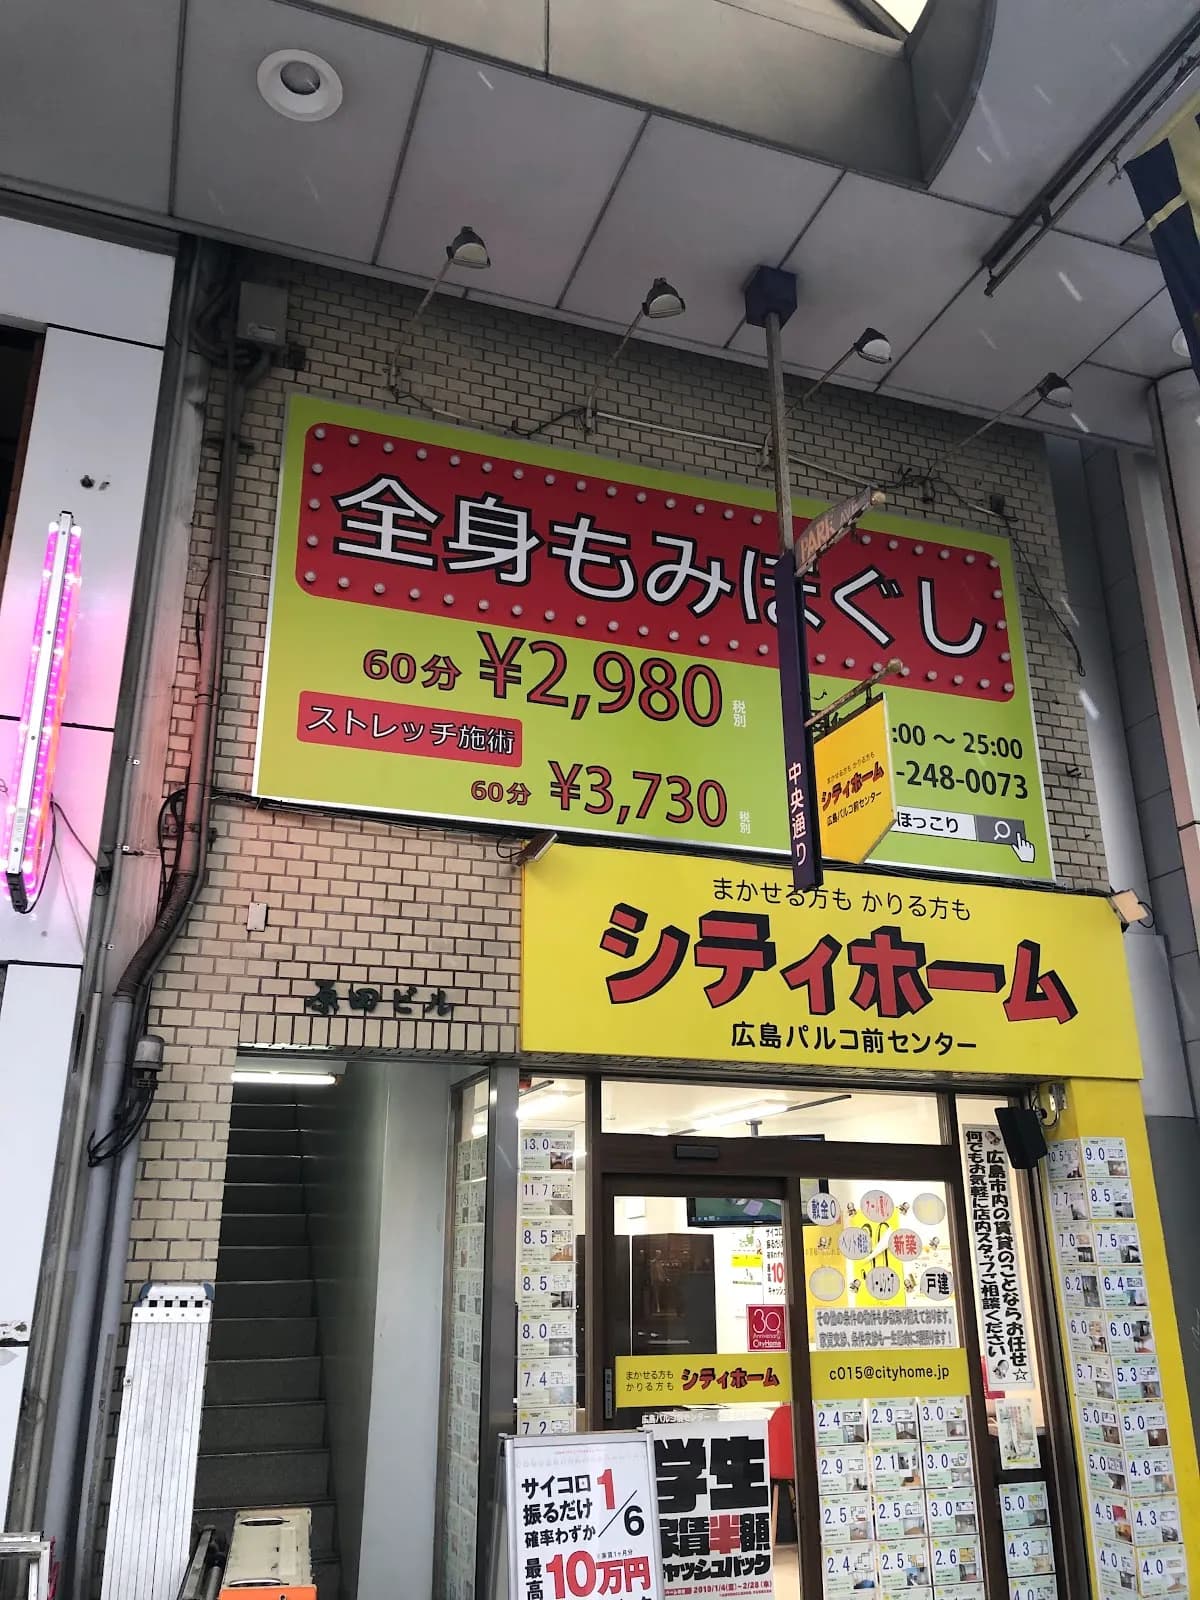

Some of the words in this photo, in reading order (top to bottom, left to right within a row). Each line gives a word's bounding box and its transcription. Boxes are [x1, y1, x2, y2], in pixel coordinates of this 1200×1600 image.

[363, 649, 462, 691] 60分
[476, 631, 723, 727] ¥2,980
[732, 699, 747, 728] 税別
[306, 705, 515, 755] ストレッチ施術
[963, 731, 1023, 760] 25:00
[470, 780, 531, 807] 60分
[548, 761, 727, 828] ¥3,730
[821, 762, 885, 811] シティホーム
[788, 762, 807, 866] 中央通り
[713, 877, 852, 911] まかせる方も
[862, 890, 971, 921] かりる方も
[599, 902, 1077, 1025] シティホーム
[731, 1021, 977, 1056] 広島パルコ前センター
[524, 1138, 549, 1151] 13.0
[523, 1229, 548, 1245] 8.5
[893, 1234, 917, 1256] 新築
[522, 1275, 547, 1291] 8.5
[925, 1272, 950, 1295] 戸建
[522, 1323, 547, 1339] 8.0
[753, 1308, 781, 1334] 30
[523, 1371, 548, 1388] 7.4
[626, 1370, 674, 1380] まかせる方も
[680, 1367, 780, 1391] シティホーム
[829, 1364, 949, 1381] c015@cityhome.jp
[626, 1382, 674, 1392] かりる方も
[522, 1474, 592, 1499] サイコロ
[655, 1436, 769, 1514] 学生
[523, 1498, 593, 1526] 振るだけ
[525, 1525, 596, 1549] 確率わずか
[545, 1550, 652, 1600] 10万円
